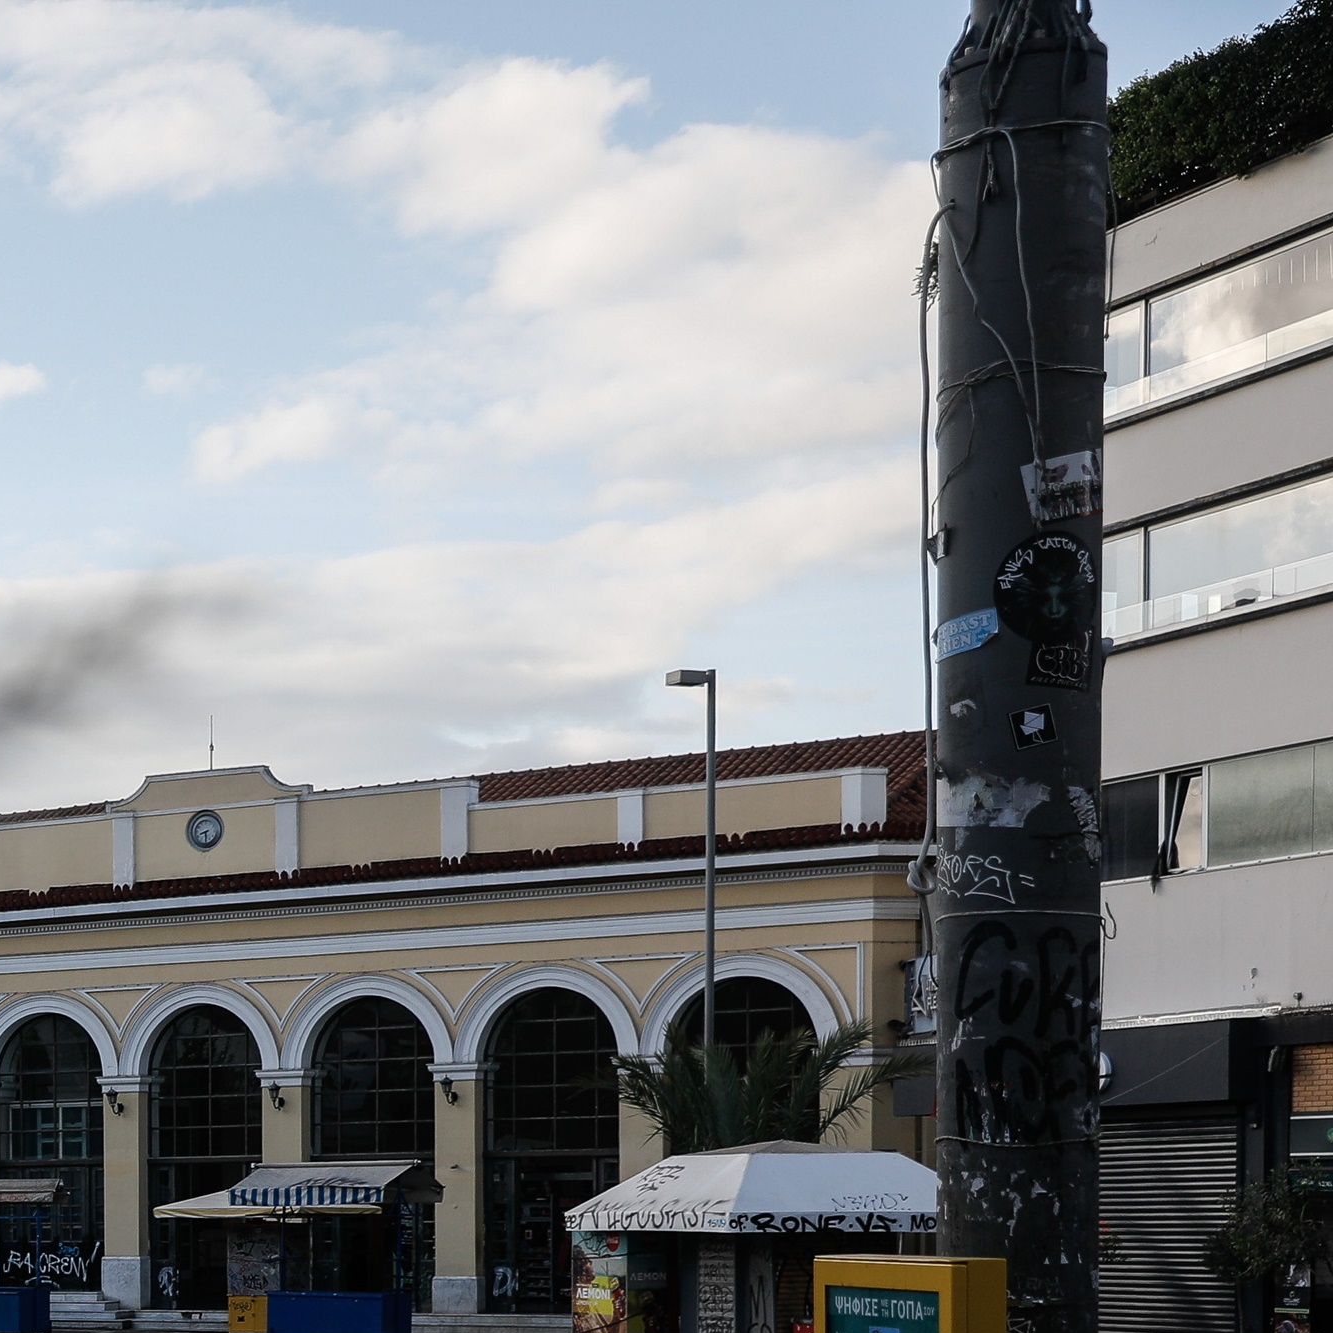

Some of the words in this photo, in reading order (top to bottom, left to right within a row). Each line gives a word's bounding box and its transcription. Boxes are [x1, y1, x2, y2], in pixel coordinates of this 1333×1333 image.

[949, 613, 992, 637] BÄST
[835, 1295, 879, 1317] ΨΗΦΙΣΕ
[890, 1299, 924, 1321] ΓΟΠΑ
[924, 1306, 935, 1316] ΣΟΥ
[881, 1308, 889, 1318] ΤΗ
